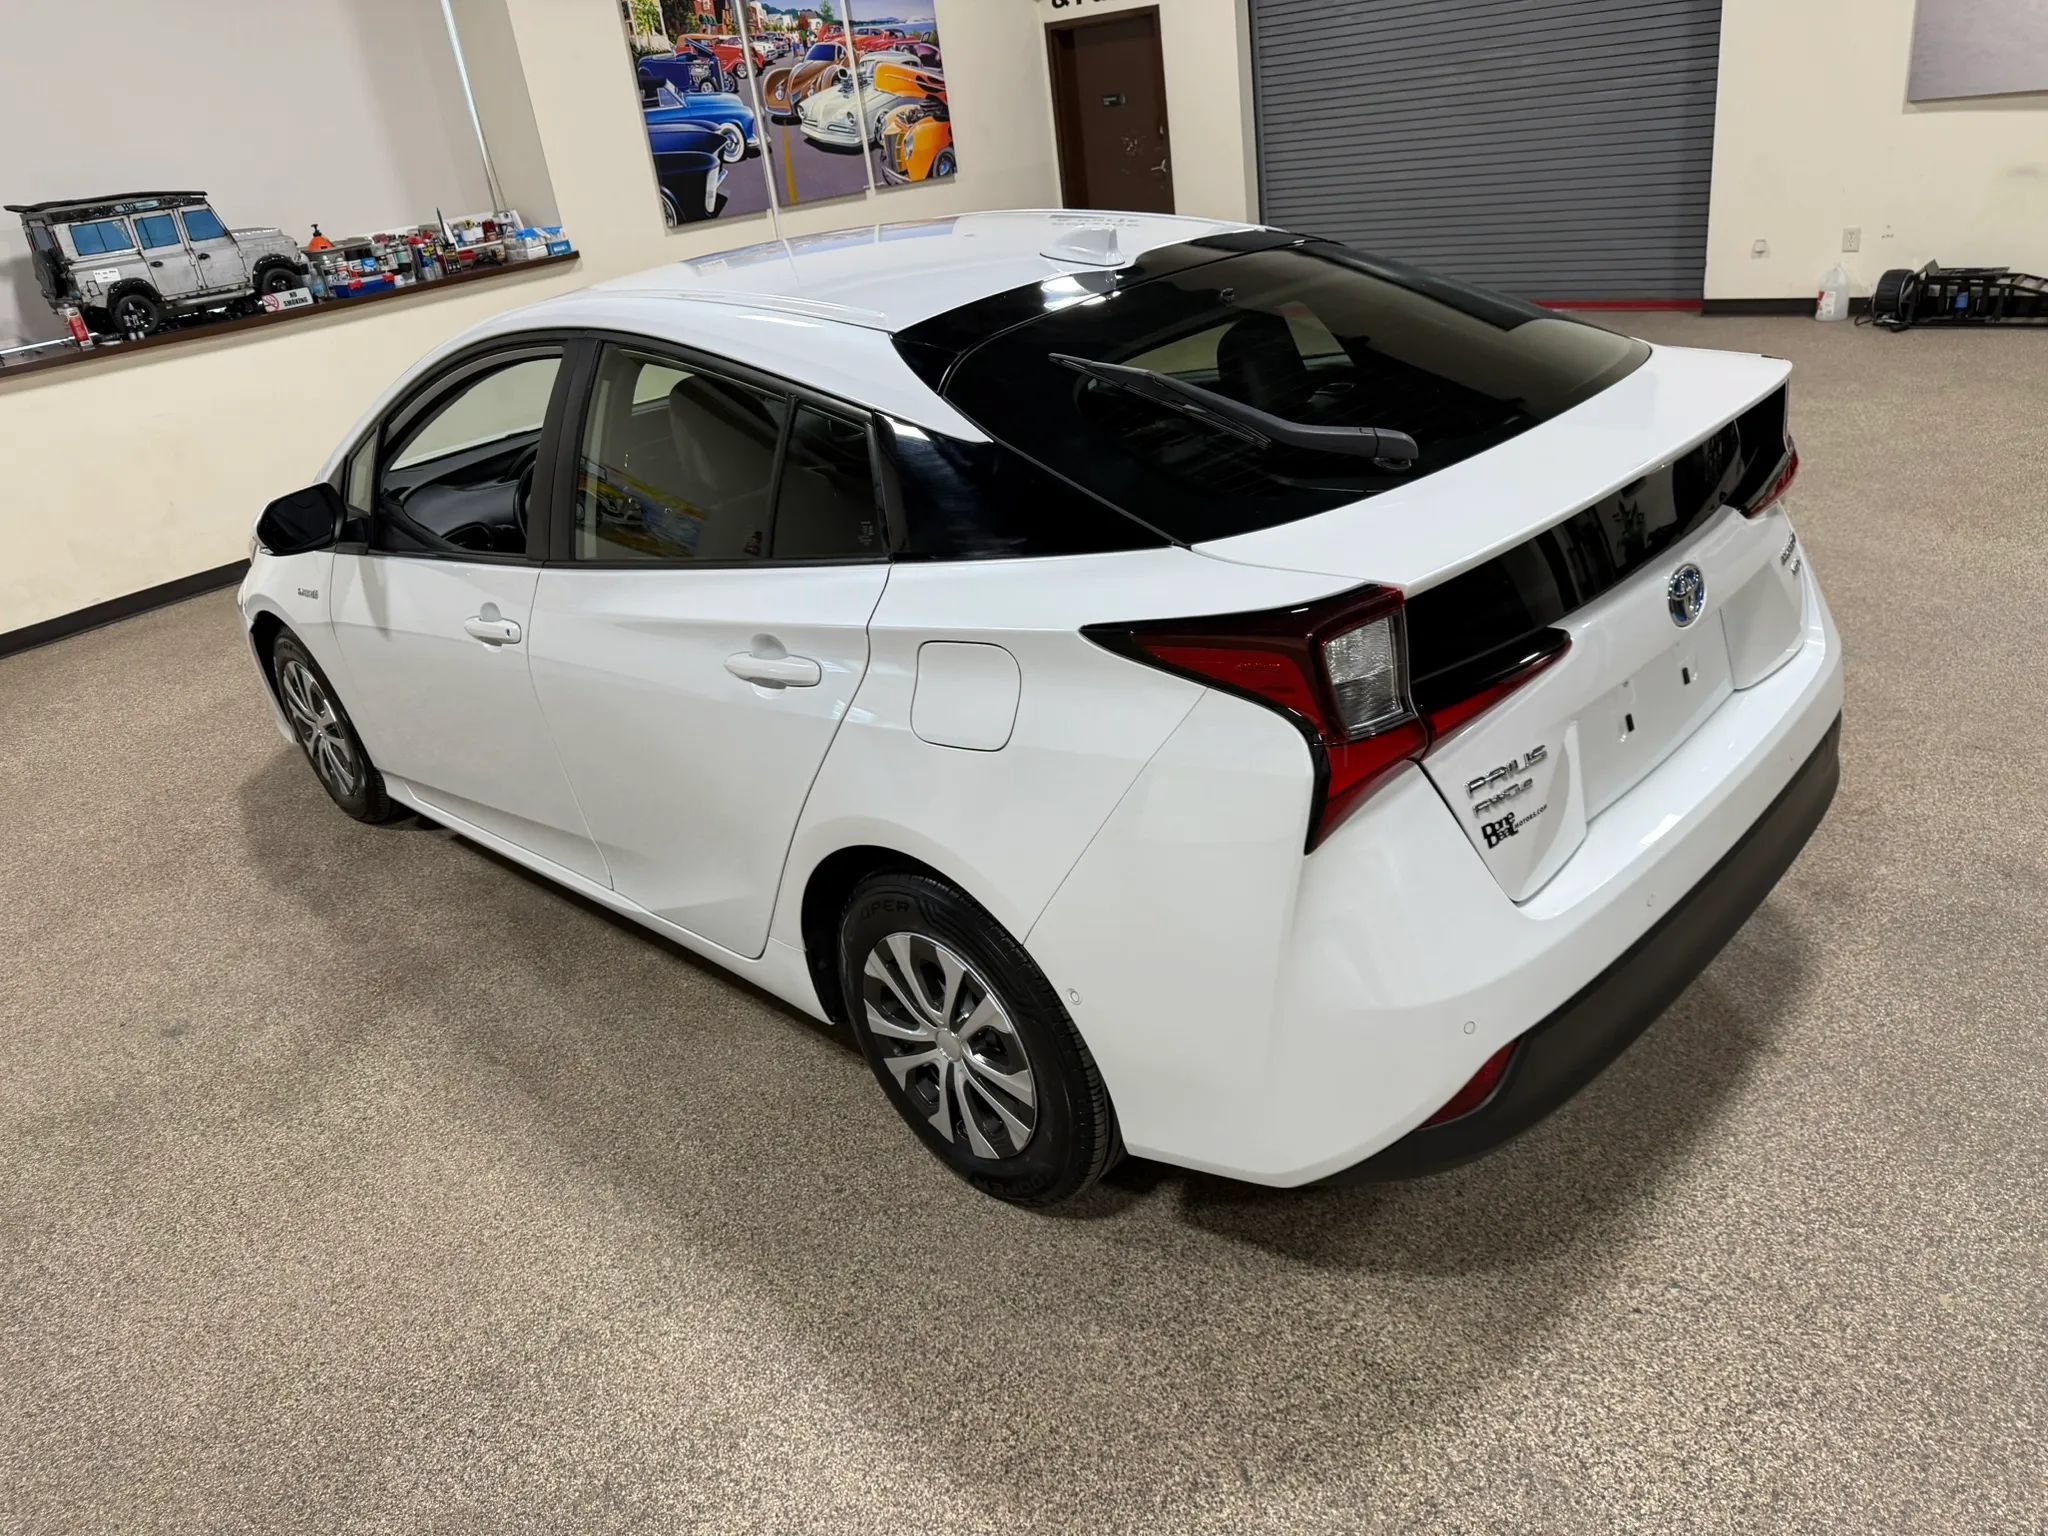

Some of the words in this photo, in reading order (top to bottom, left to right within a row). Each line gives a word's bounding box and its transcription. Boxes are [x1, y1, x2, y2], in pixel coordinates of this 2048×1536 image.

[283, 297, 309, 307] SMOKING
[1464, 744, 1548, 798] PRIUS
[1481, 812, 1516, 840] Done
